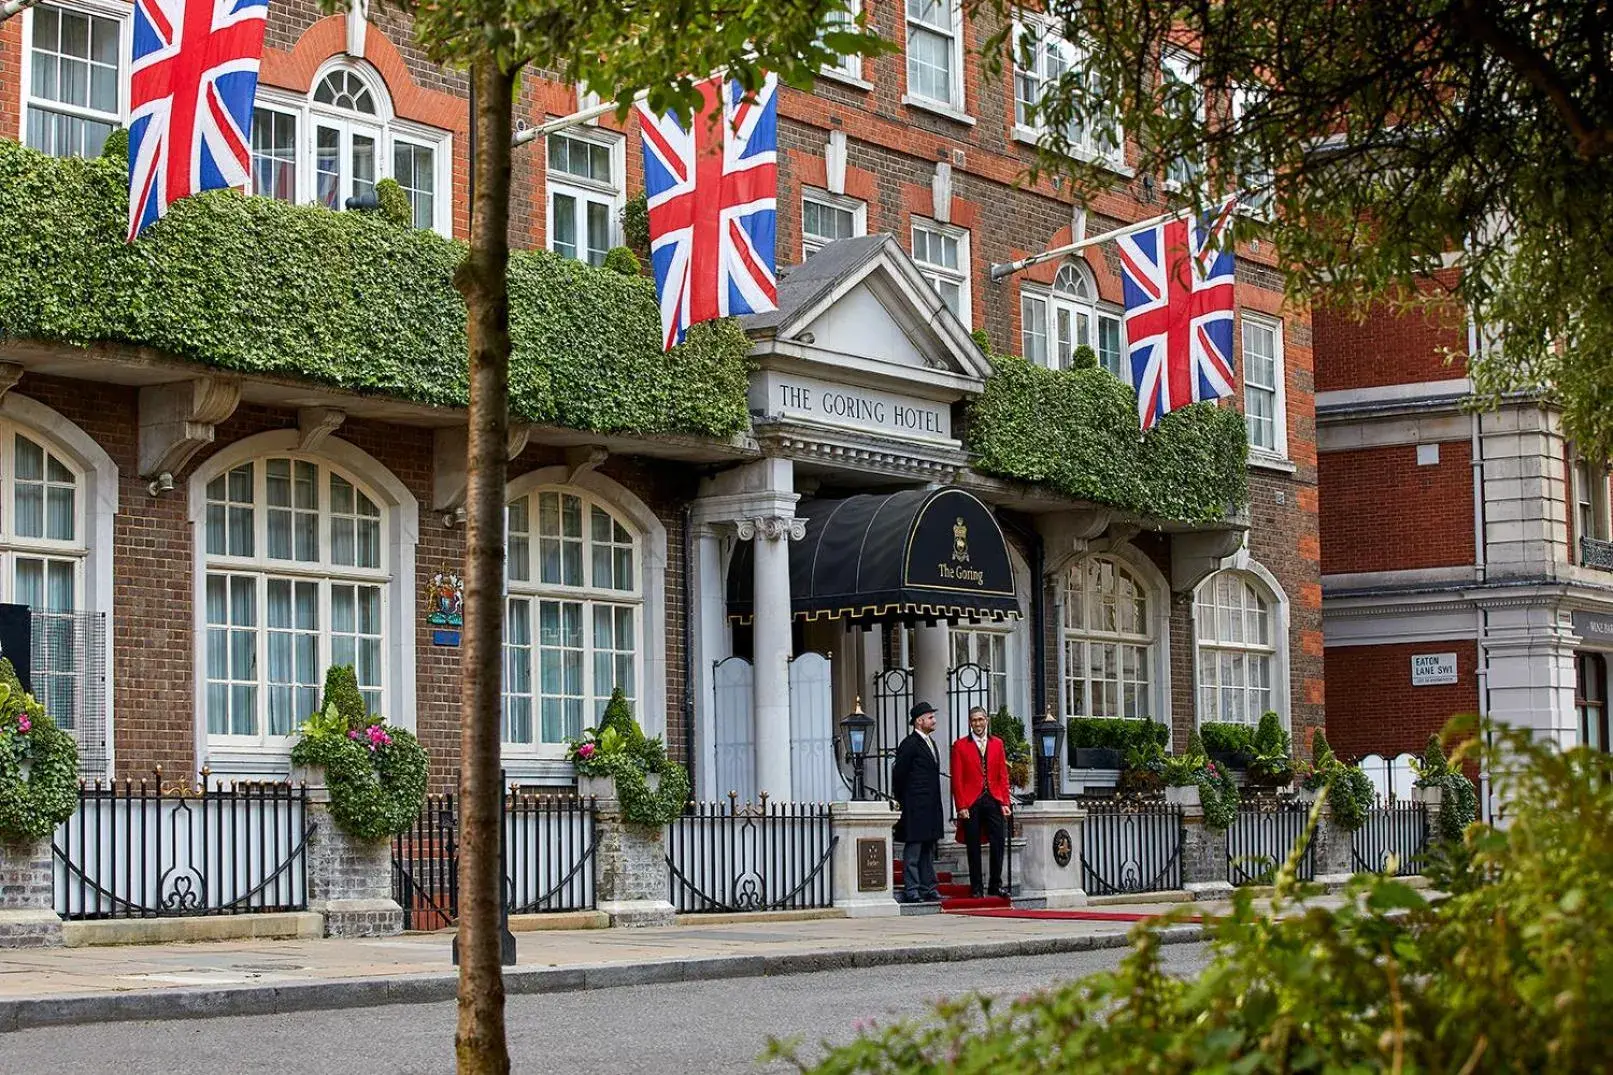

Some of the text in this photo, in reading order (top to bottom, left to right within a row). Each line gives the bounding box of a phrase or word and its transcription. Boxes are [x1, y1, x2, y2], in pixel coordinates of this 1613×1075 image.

[779, 384, 943, 434] THE GORING HOTEL
[938, 563, 984, 585] The Goring
[1415, 656, 1440, 666] EATON
[1415, 665, 1453, 675] LANE SW1
